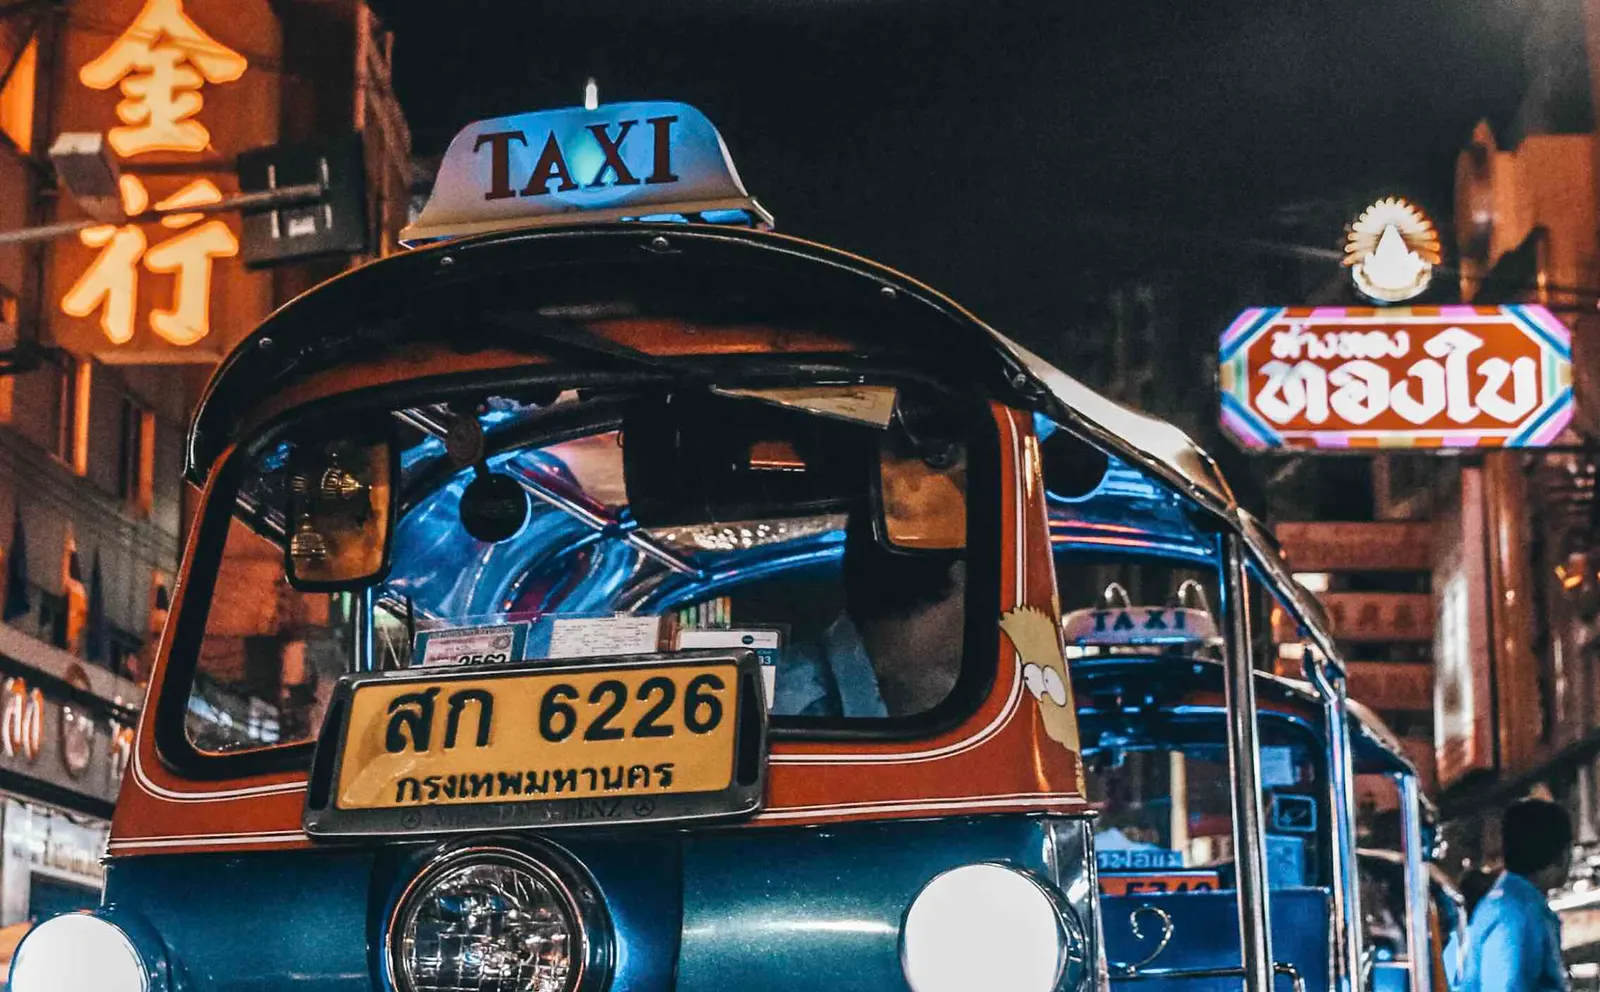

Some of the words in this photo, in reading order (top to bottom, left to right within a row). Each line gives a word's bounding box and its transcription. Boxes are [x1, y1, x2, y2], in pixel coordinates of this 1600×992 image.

[61, 0, 248, 346] 金行
[473, 115, 679, 201] TAXI
[1255, 326, 1538, 425] ทองใบ
[1090, 609, 1186, 632] TAXI
[385, 686, 494, 754] สก
[539, 673, 726, 743] 6226
[396, 762, 675, 803] กรงเทพมหานคร
